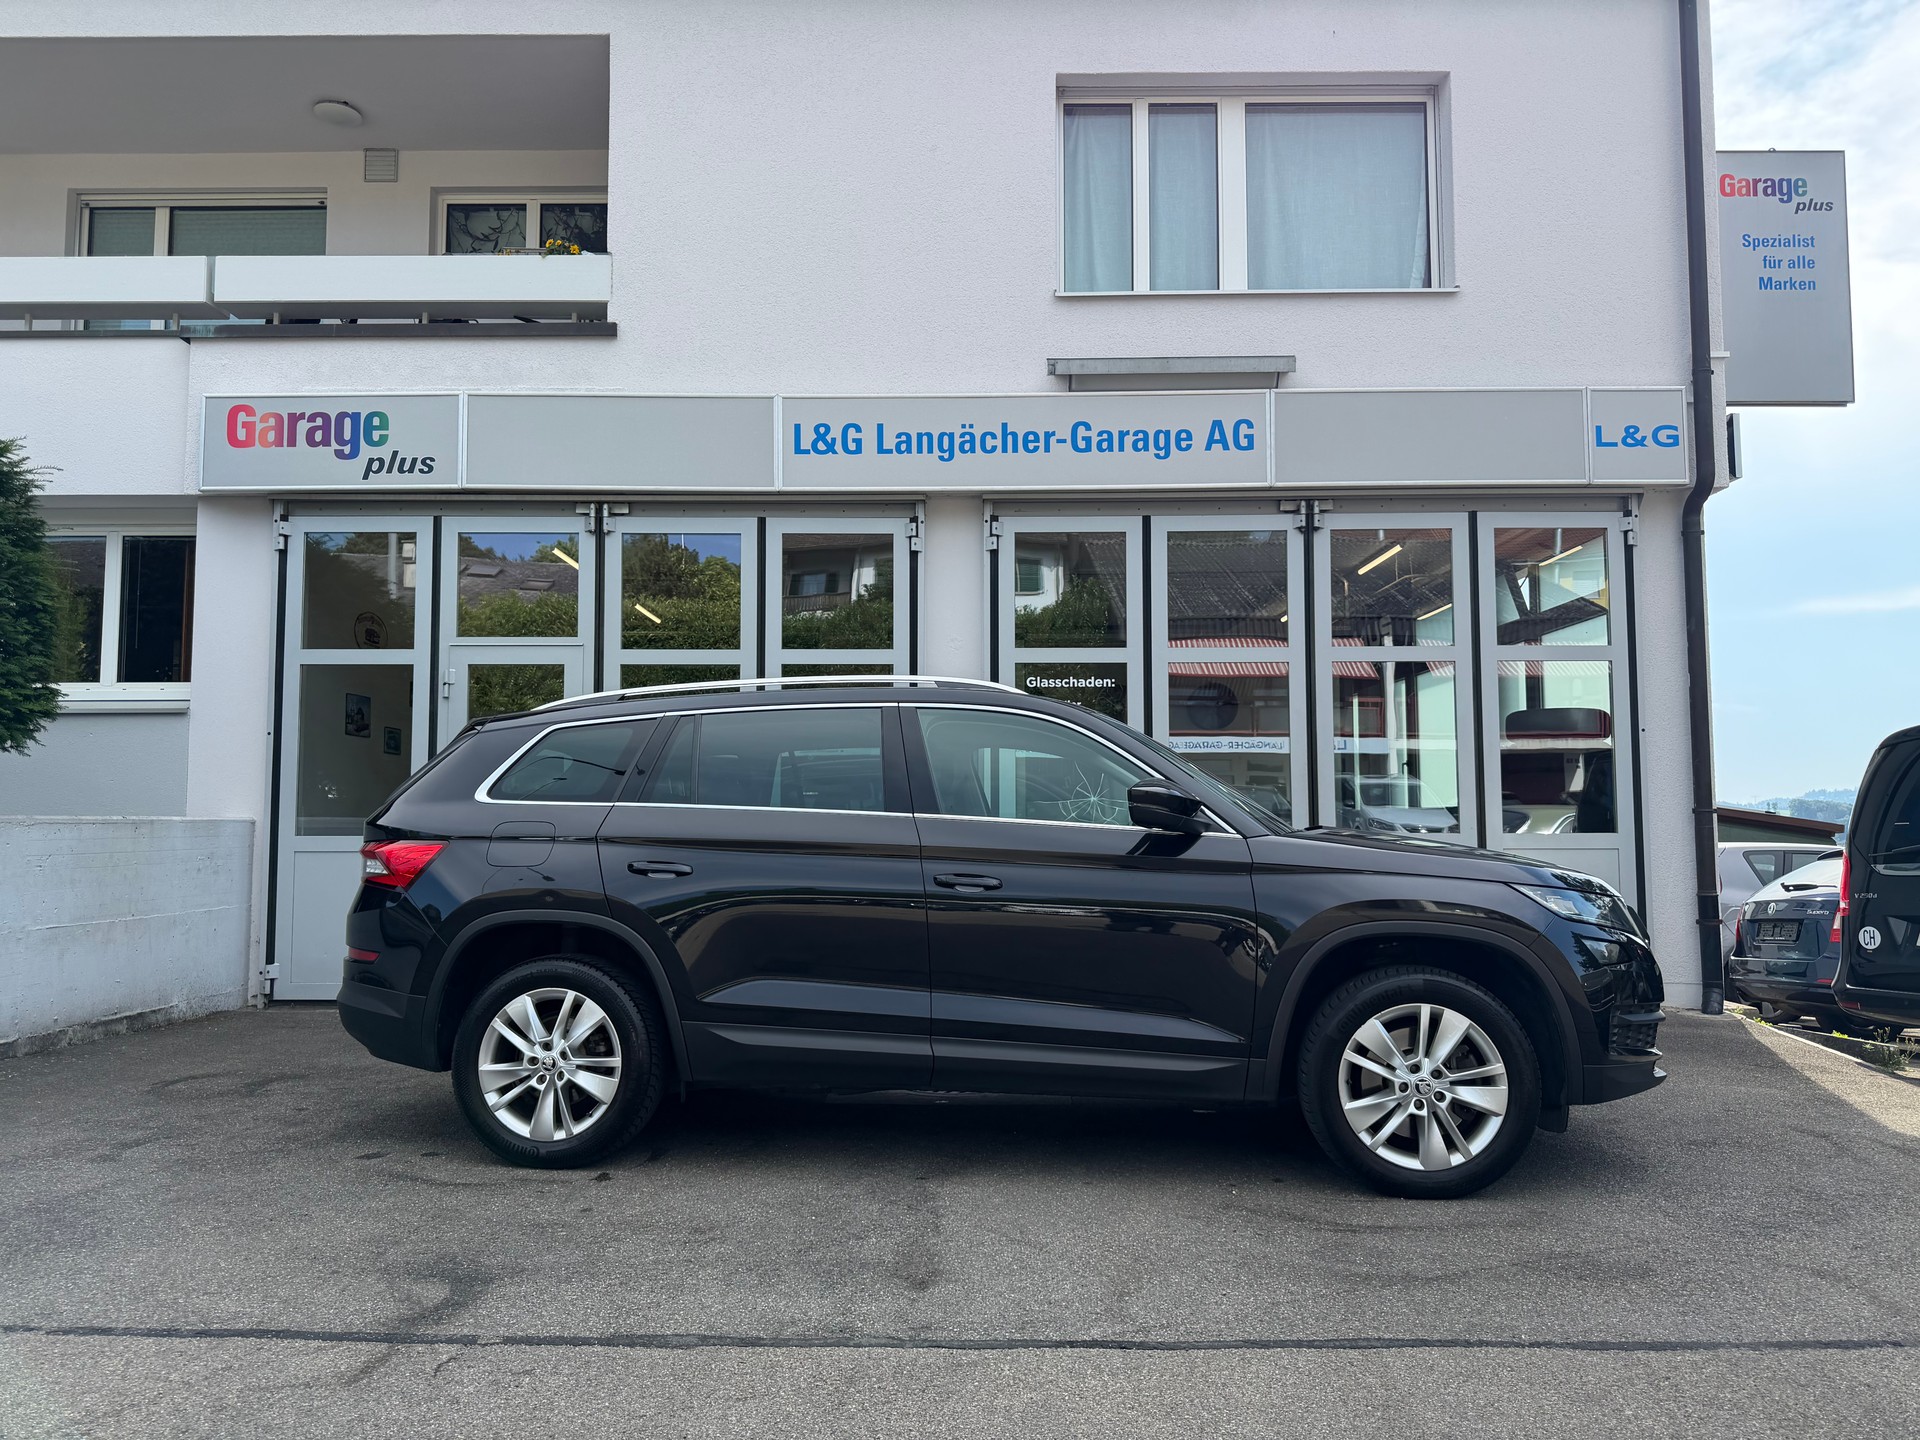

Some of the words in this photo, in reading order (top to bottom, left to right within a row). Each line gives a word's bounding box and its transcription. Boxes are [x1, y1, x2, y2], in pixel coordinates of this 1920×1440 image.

[1719, 173, 1808, 204] Garage
[1795, 198, 1834, 215] plus
[1742, 233, 1816, 251] Spezialist
[1762, 255, 1784, 270] für
[1787, 255, 1816, 270] alle
[1758, 277, 1817, 292] Marken
[226, 404, 390, 461] Garage
[793, 422, 864, 457] L&G
[876, 420, 1194, 464] Langächer-Garage
[1204, 418, 1256, 453] AG
[1594, 423, 1681, 449] L&G
[361, 450, 436, 481] plus
[1026, 676, 1116, 688] Glasschaden:
[1862, 929, 1876, 946] CH
